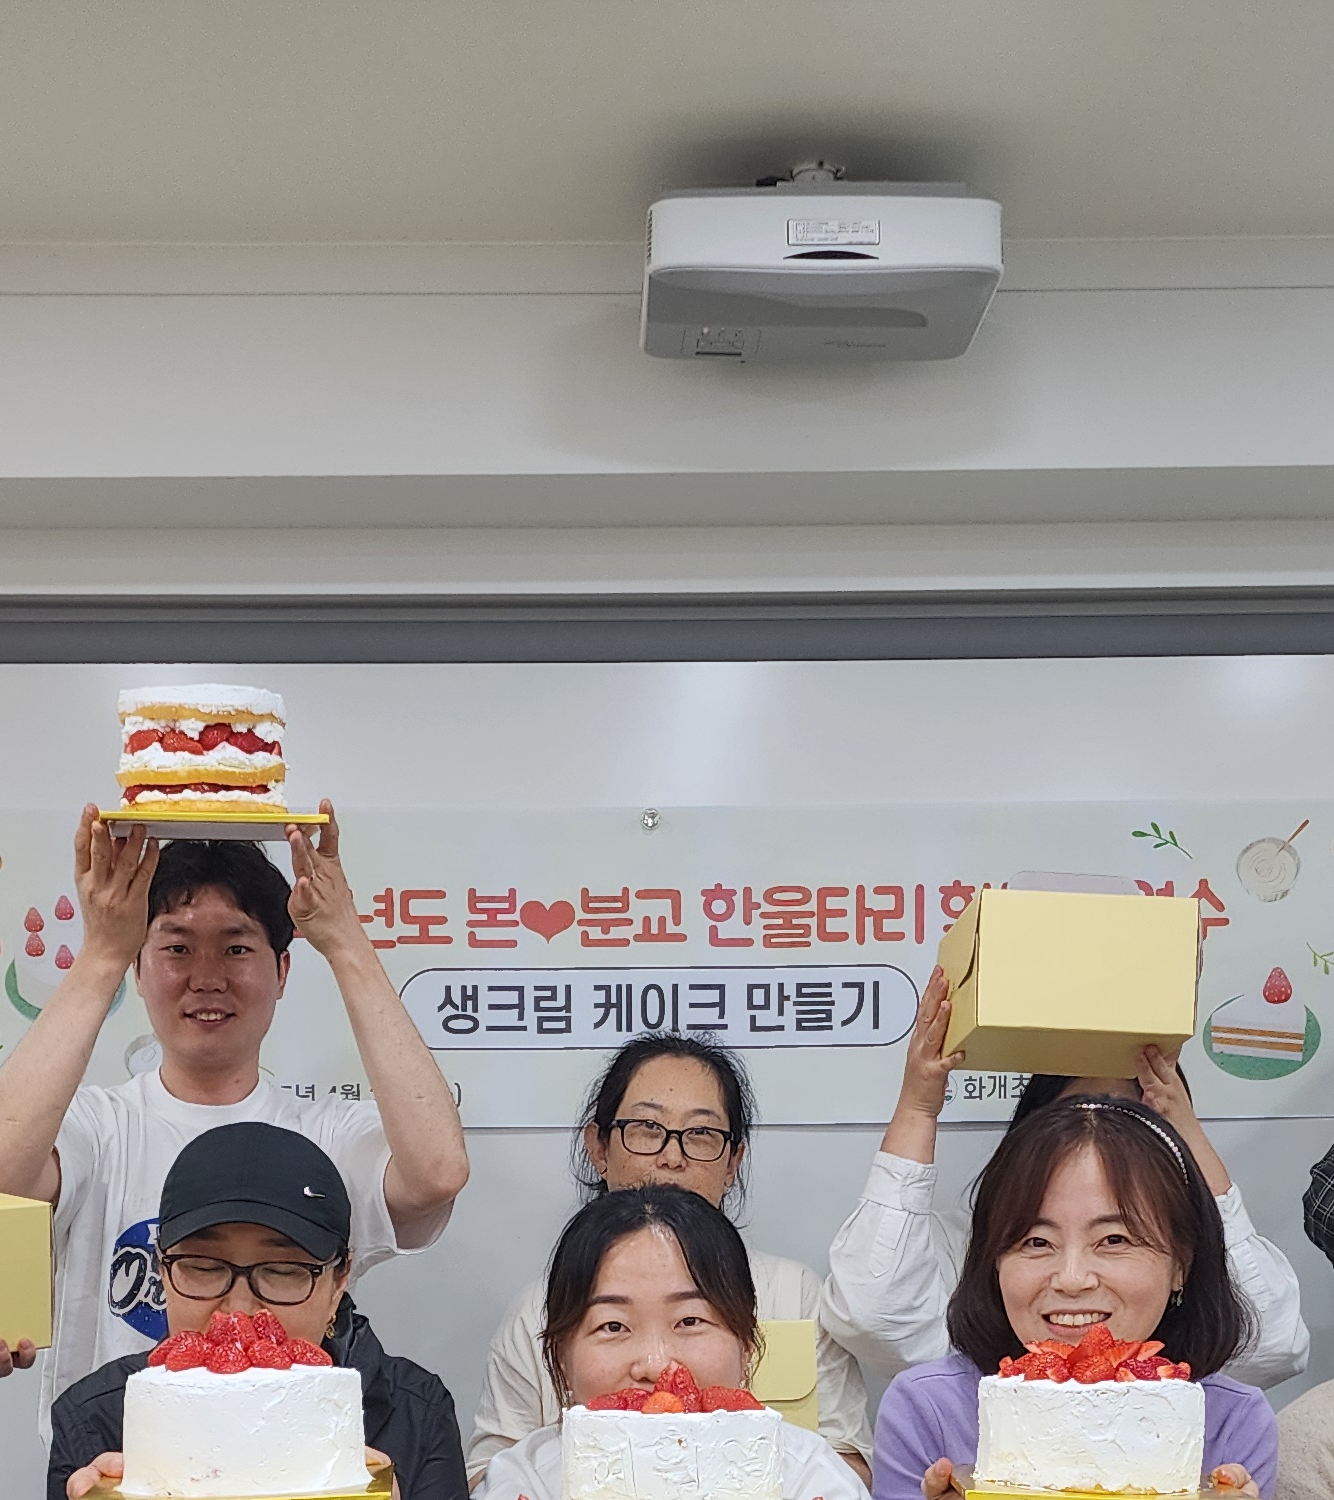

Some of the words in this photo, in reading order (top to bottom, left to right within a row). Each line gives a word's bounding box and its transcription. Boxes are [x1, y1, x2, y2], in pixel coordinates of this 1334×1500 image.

[702, 883, 925, 949] 한울타리
[437, 984, 573, 1035] 생크림
[593, 983, 729, 1033] 케이크
[746, 980, 880, 1033] 만들기
